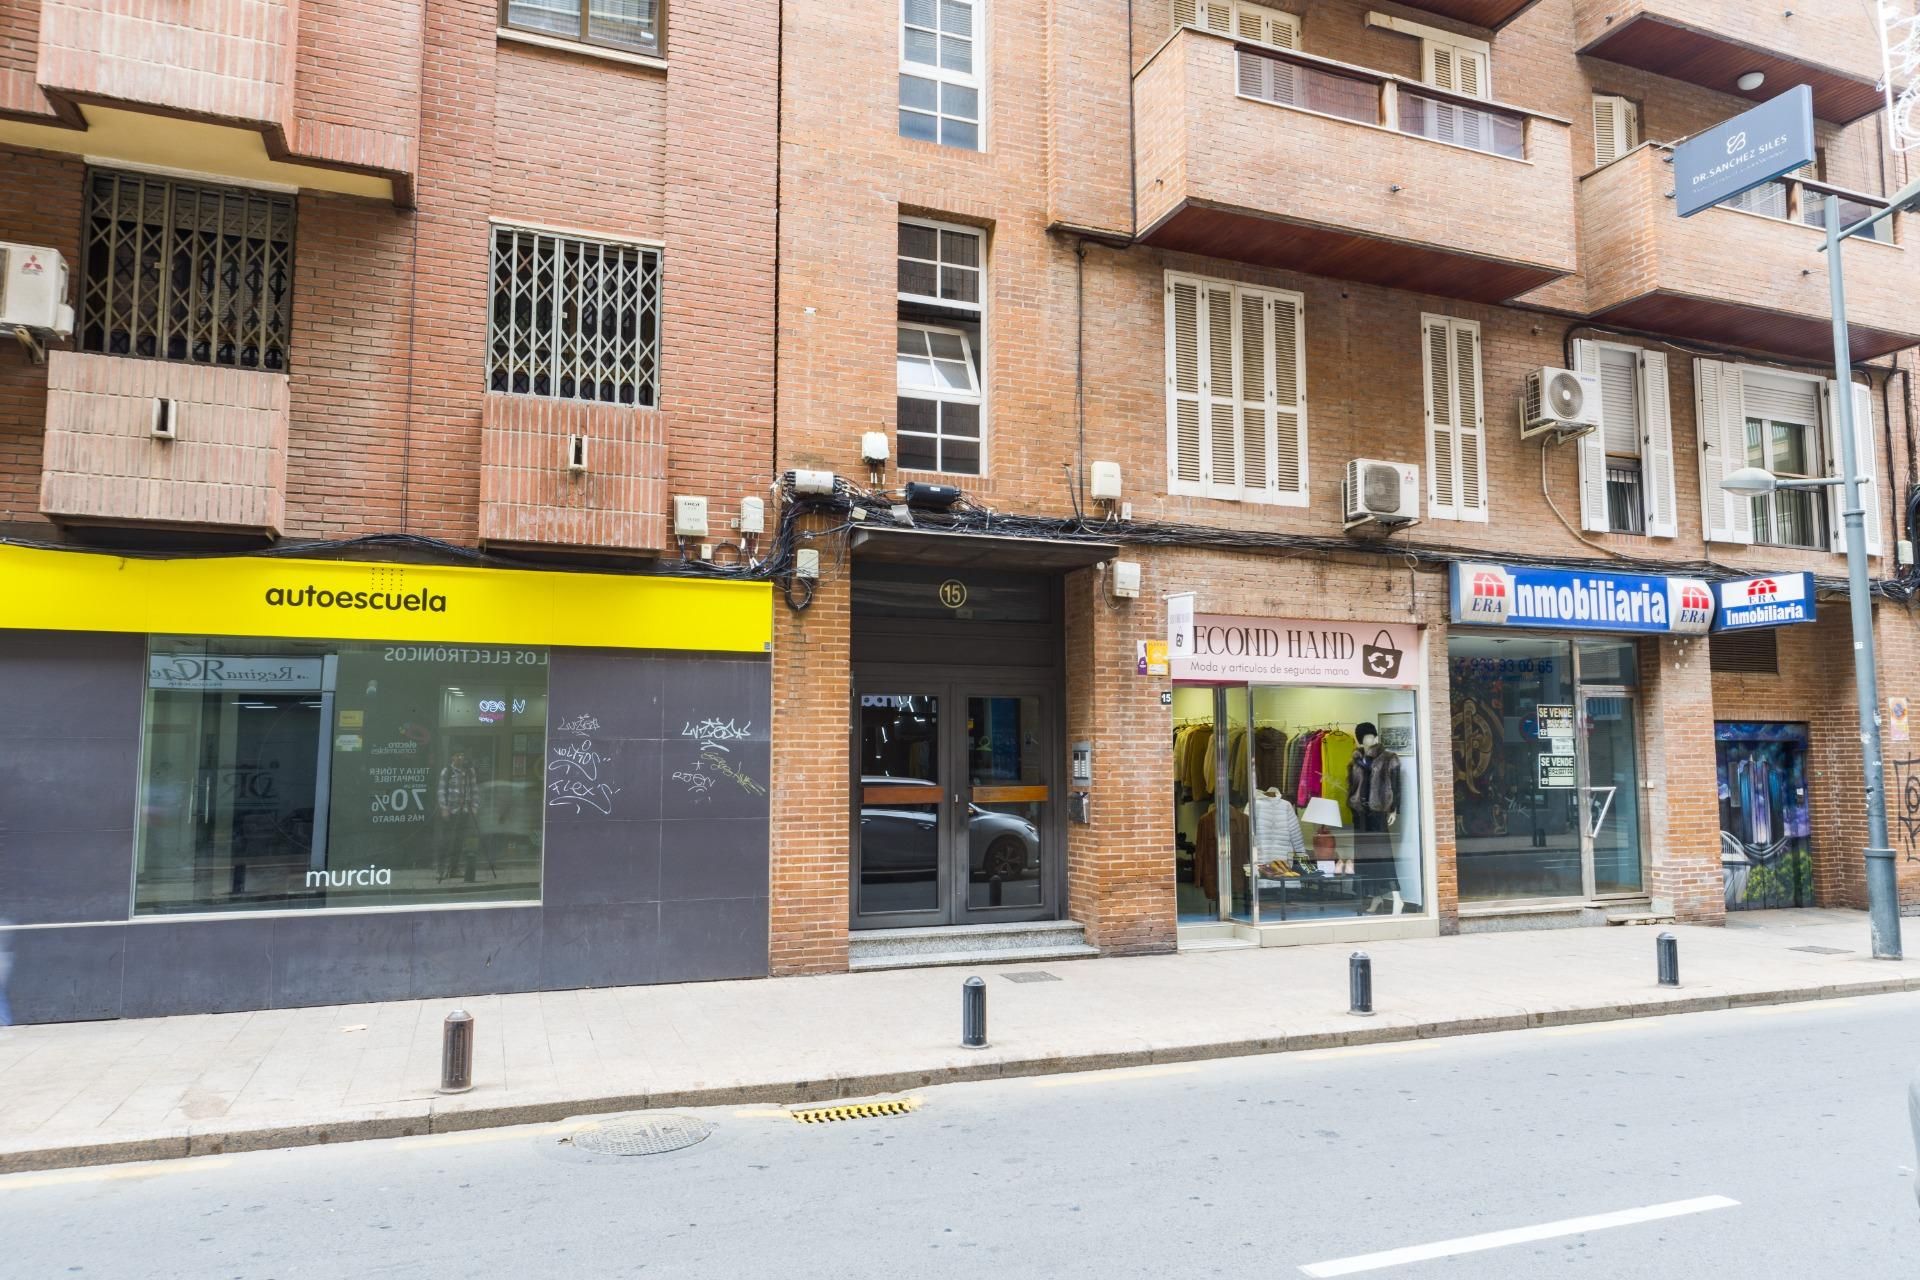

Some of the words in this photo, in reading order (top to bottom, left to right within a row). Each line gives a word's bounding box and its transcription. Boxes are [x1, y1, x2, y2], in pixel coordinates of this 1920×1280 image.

[1758, 134, 1788, 154] SILES
[265, 584, 447, 613] autoescuela
[944, 584, 961, 603] 15
[1505, 574, 1667, 624] Inmobiliaria
[1749, 594, 1777, 604] ERA
[1471, 598, 1503, 613] ERA
[1680, 609, 1706, 624] ERA
[1726, 603, 1804, 626] Inmobiliaria
[1193, 625, 1279, 658] ECOND
[1287, 629, 1355, 660] HAND
[1190, 662, 1218, 673] Moda
[1220, 665, 1226, 675] y
[1270, 663, 1283, 674] de
[1283, 664, 1322, 677] segunda
[1324, 668, 1350, 677] mano
[1161, 693, 1171, 703] 15
[1538, 707, 1548, 718] SE
[1549, 707, 1573, 718] VENDE
[1540, 757, 1550, 767] SE
[1551, 757, 1574, 767] VENDE
[306, 864, 391, 888] murcia
